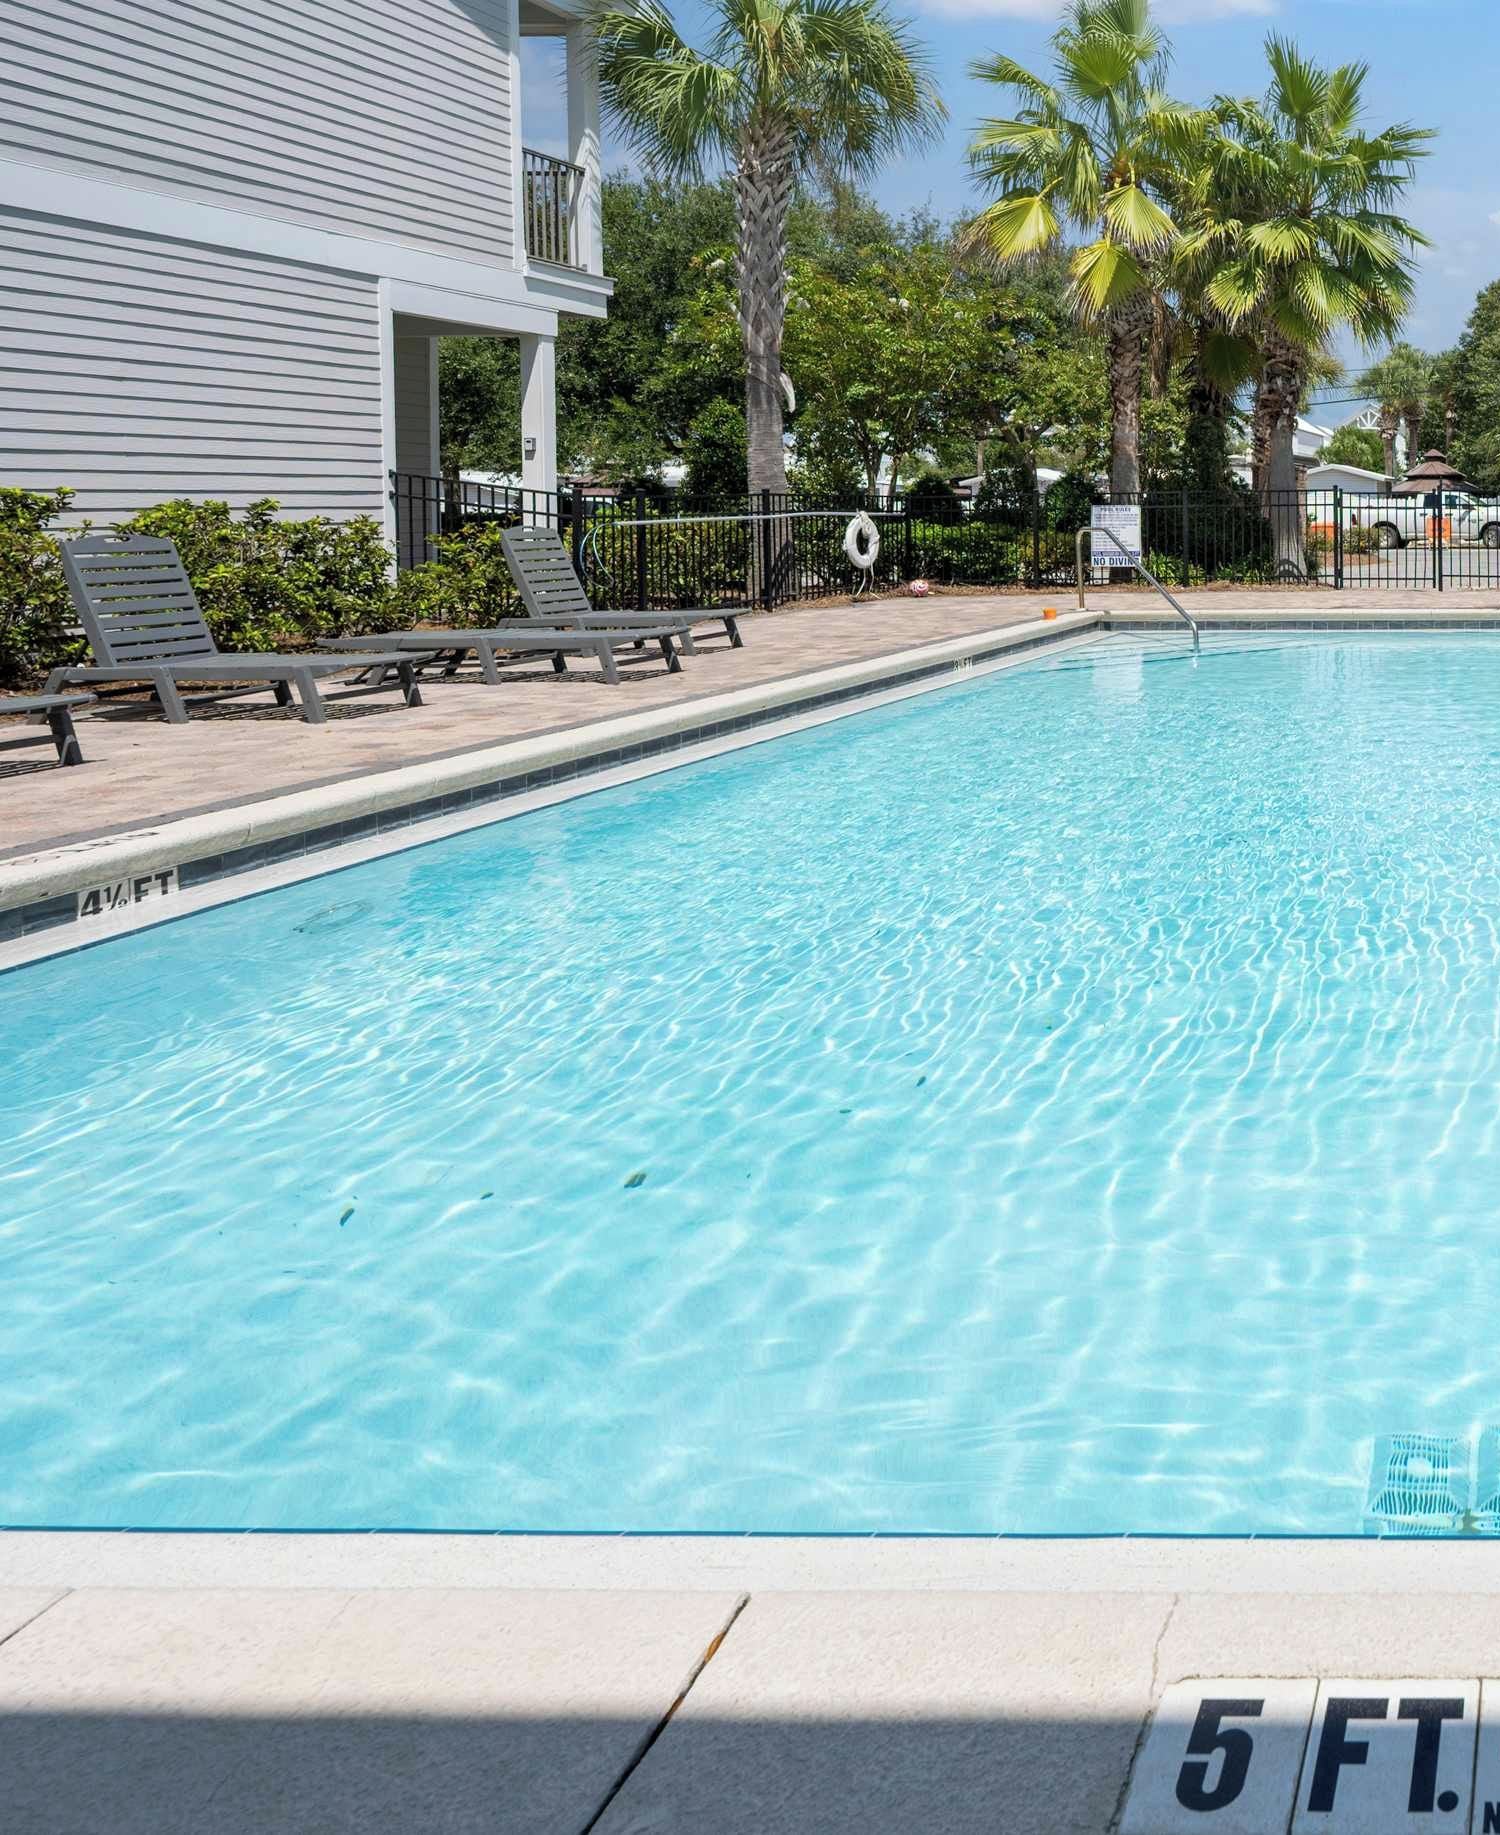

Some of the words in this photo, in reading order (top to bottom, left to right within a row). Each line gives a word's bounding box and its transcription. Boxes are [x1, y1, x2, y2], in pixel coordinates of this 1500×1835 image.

[1093, 557, 1105, 566] NO
[134, 869, 174, 903] FT
[1174, 1698, 1265, 1813] 5
[1306, 1697, 1465, 1813] FT.
